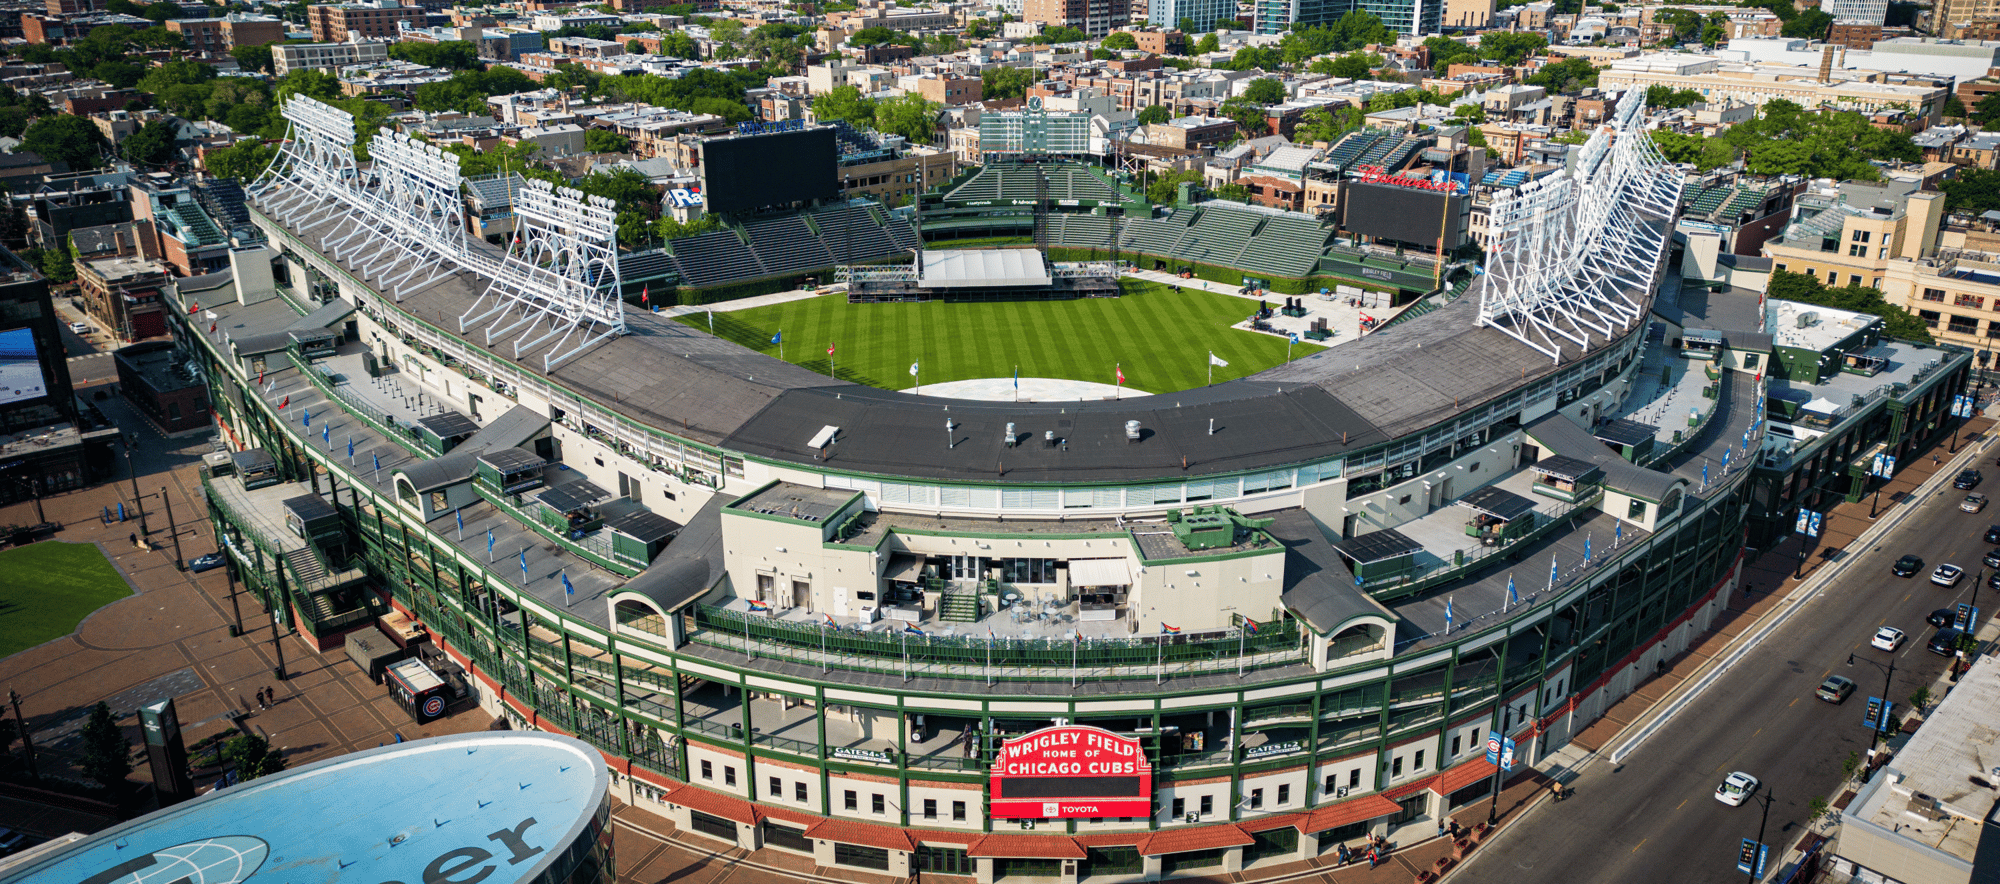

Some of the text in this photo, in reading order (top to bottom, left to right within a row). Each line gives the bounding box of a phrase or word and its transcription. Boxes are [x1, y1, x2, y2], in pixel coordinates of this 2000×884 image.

[737, 119, 805, 135] WINTRUST
[1359, 164, 1457, 192] Budweiser
[1008, 732, 1134, 758] WRIGLEY FIELD
[1249, 744, 1281, 754] GATES
[835, 747, 868, 757] GATES
[1043, 750, 1100, 758] HOME OF
[1008, 762, 1134, 775] CHICAGO CUBS
